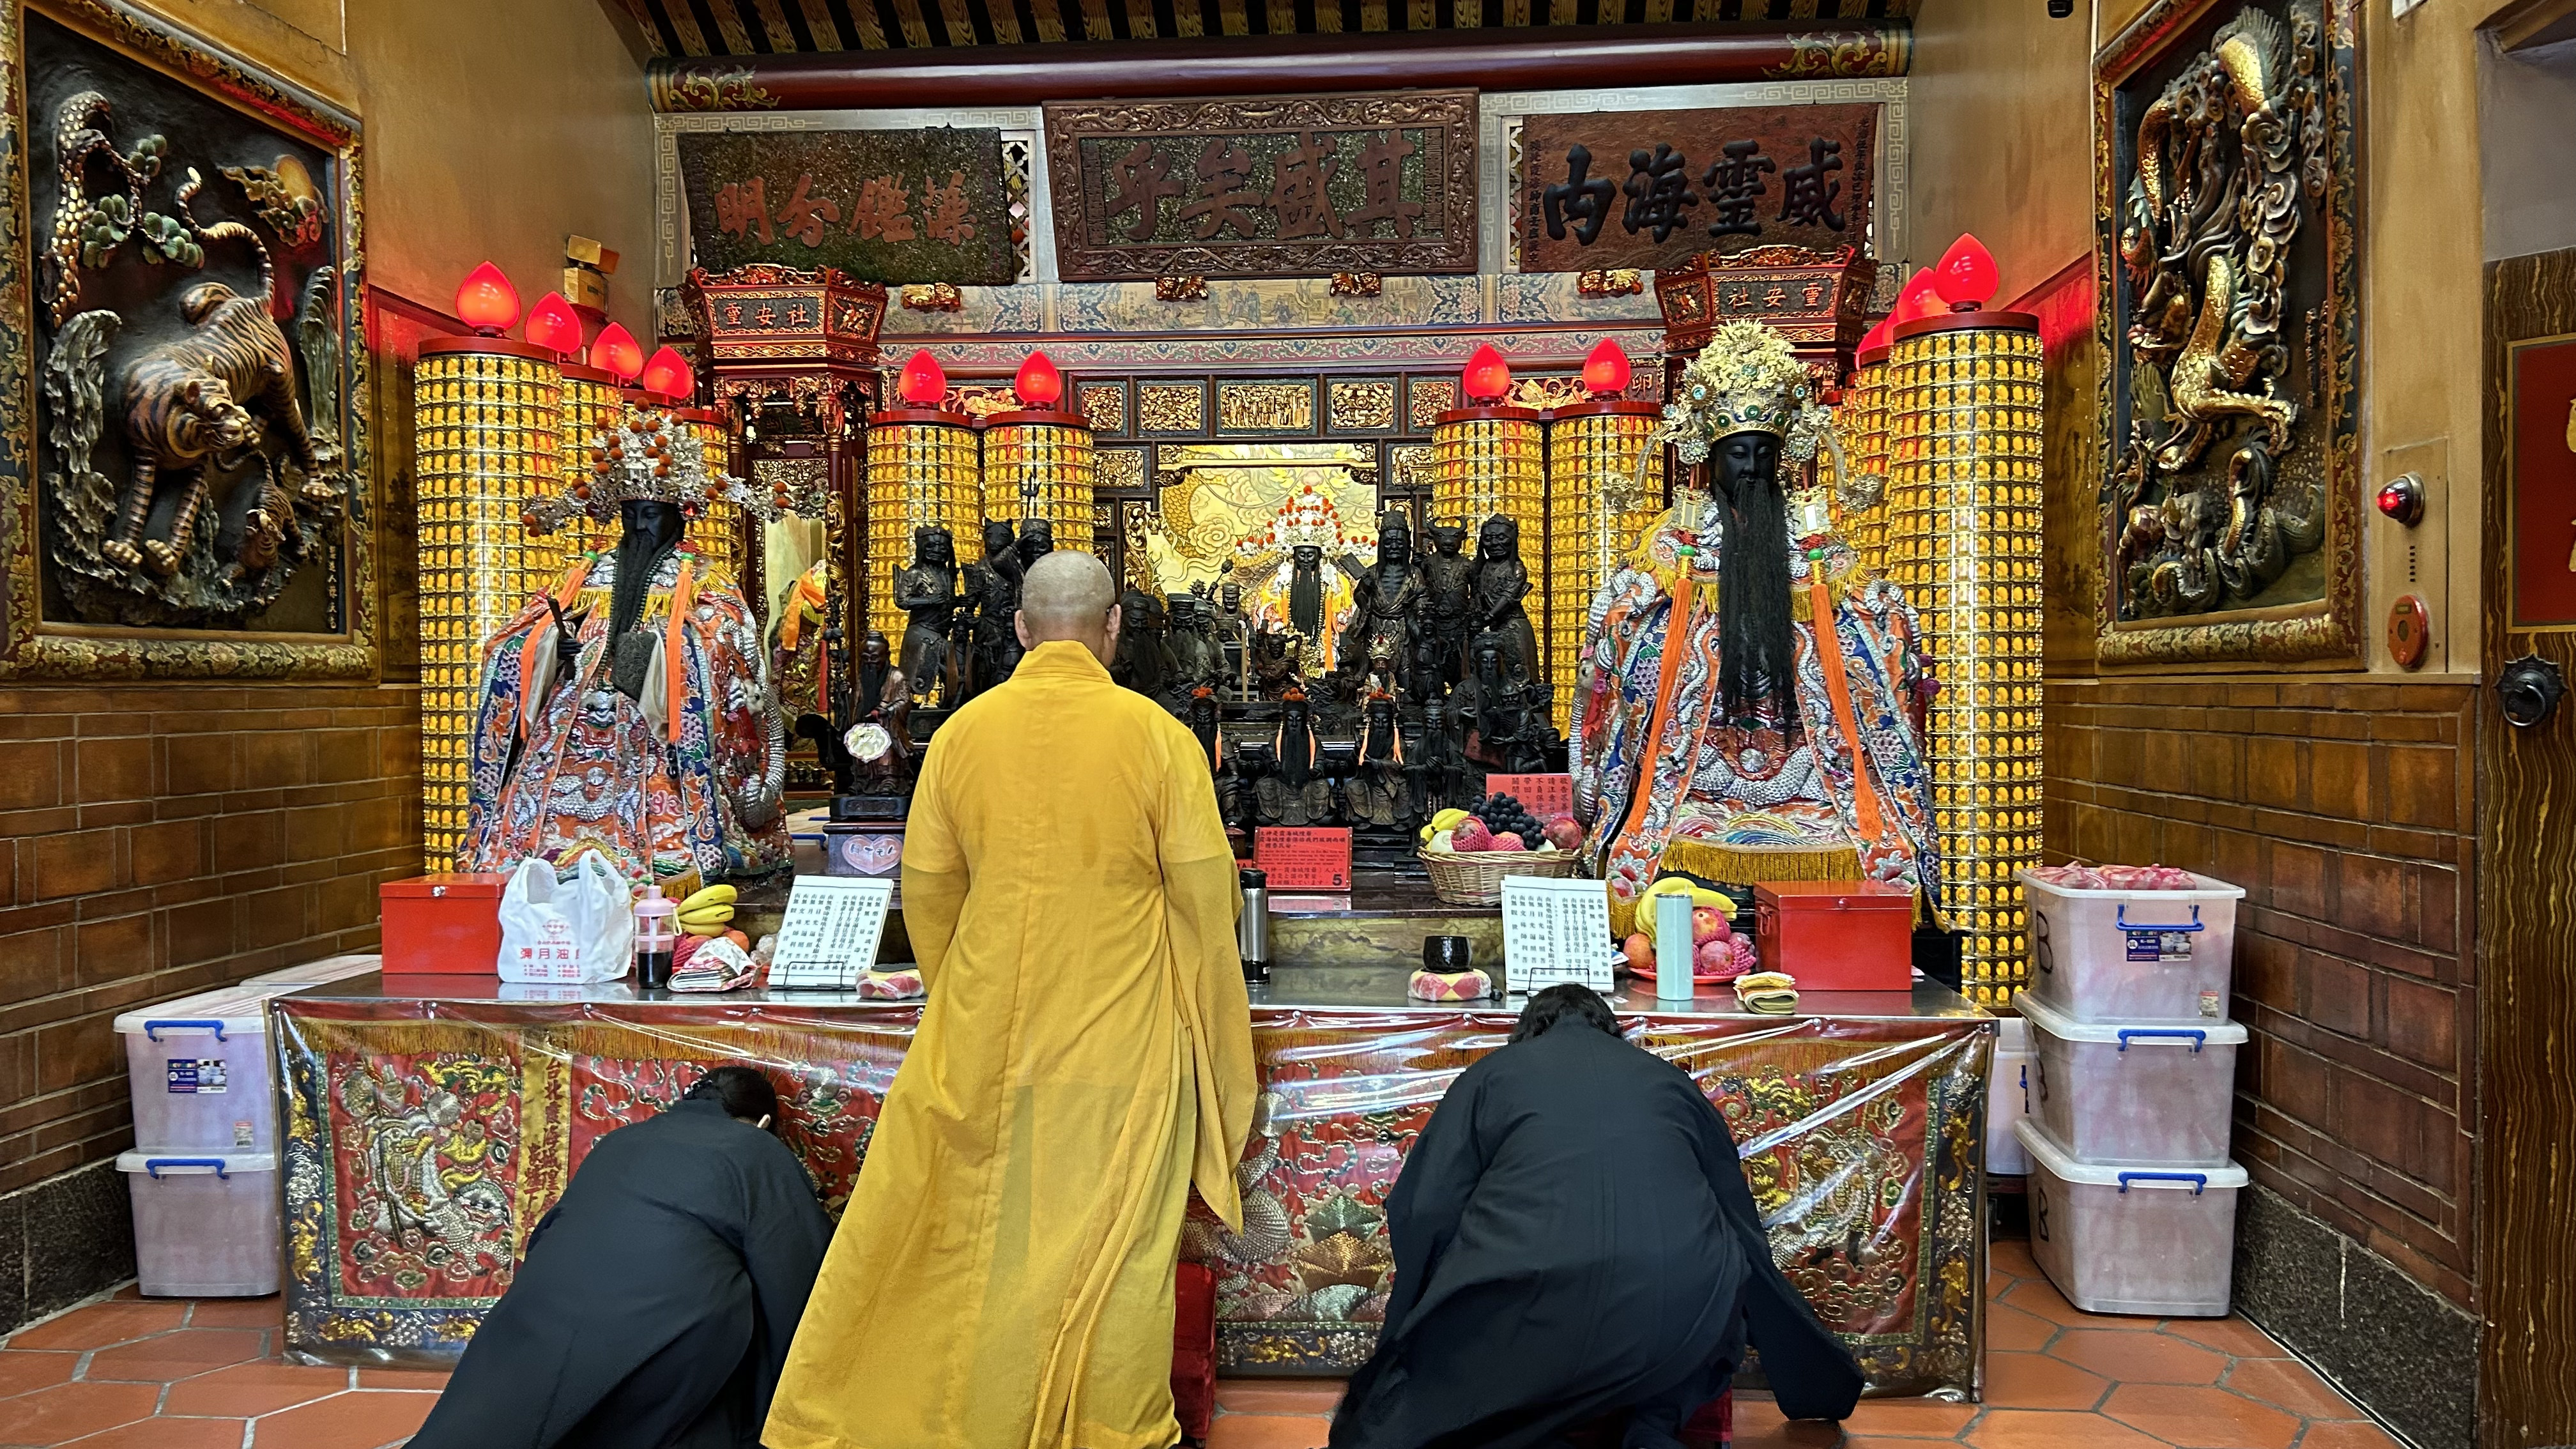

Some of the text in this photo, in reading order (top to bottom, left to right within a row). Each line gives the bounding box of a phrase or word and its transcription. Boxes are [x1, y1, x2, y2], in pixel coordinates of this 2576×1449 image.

[1333, 874, 1342, 885] 5
[2036, 910, 2053, 974] B
[2039, 1186, 2049, 1242] B
